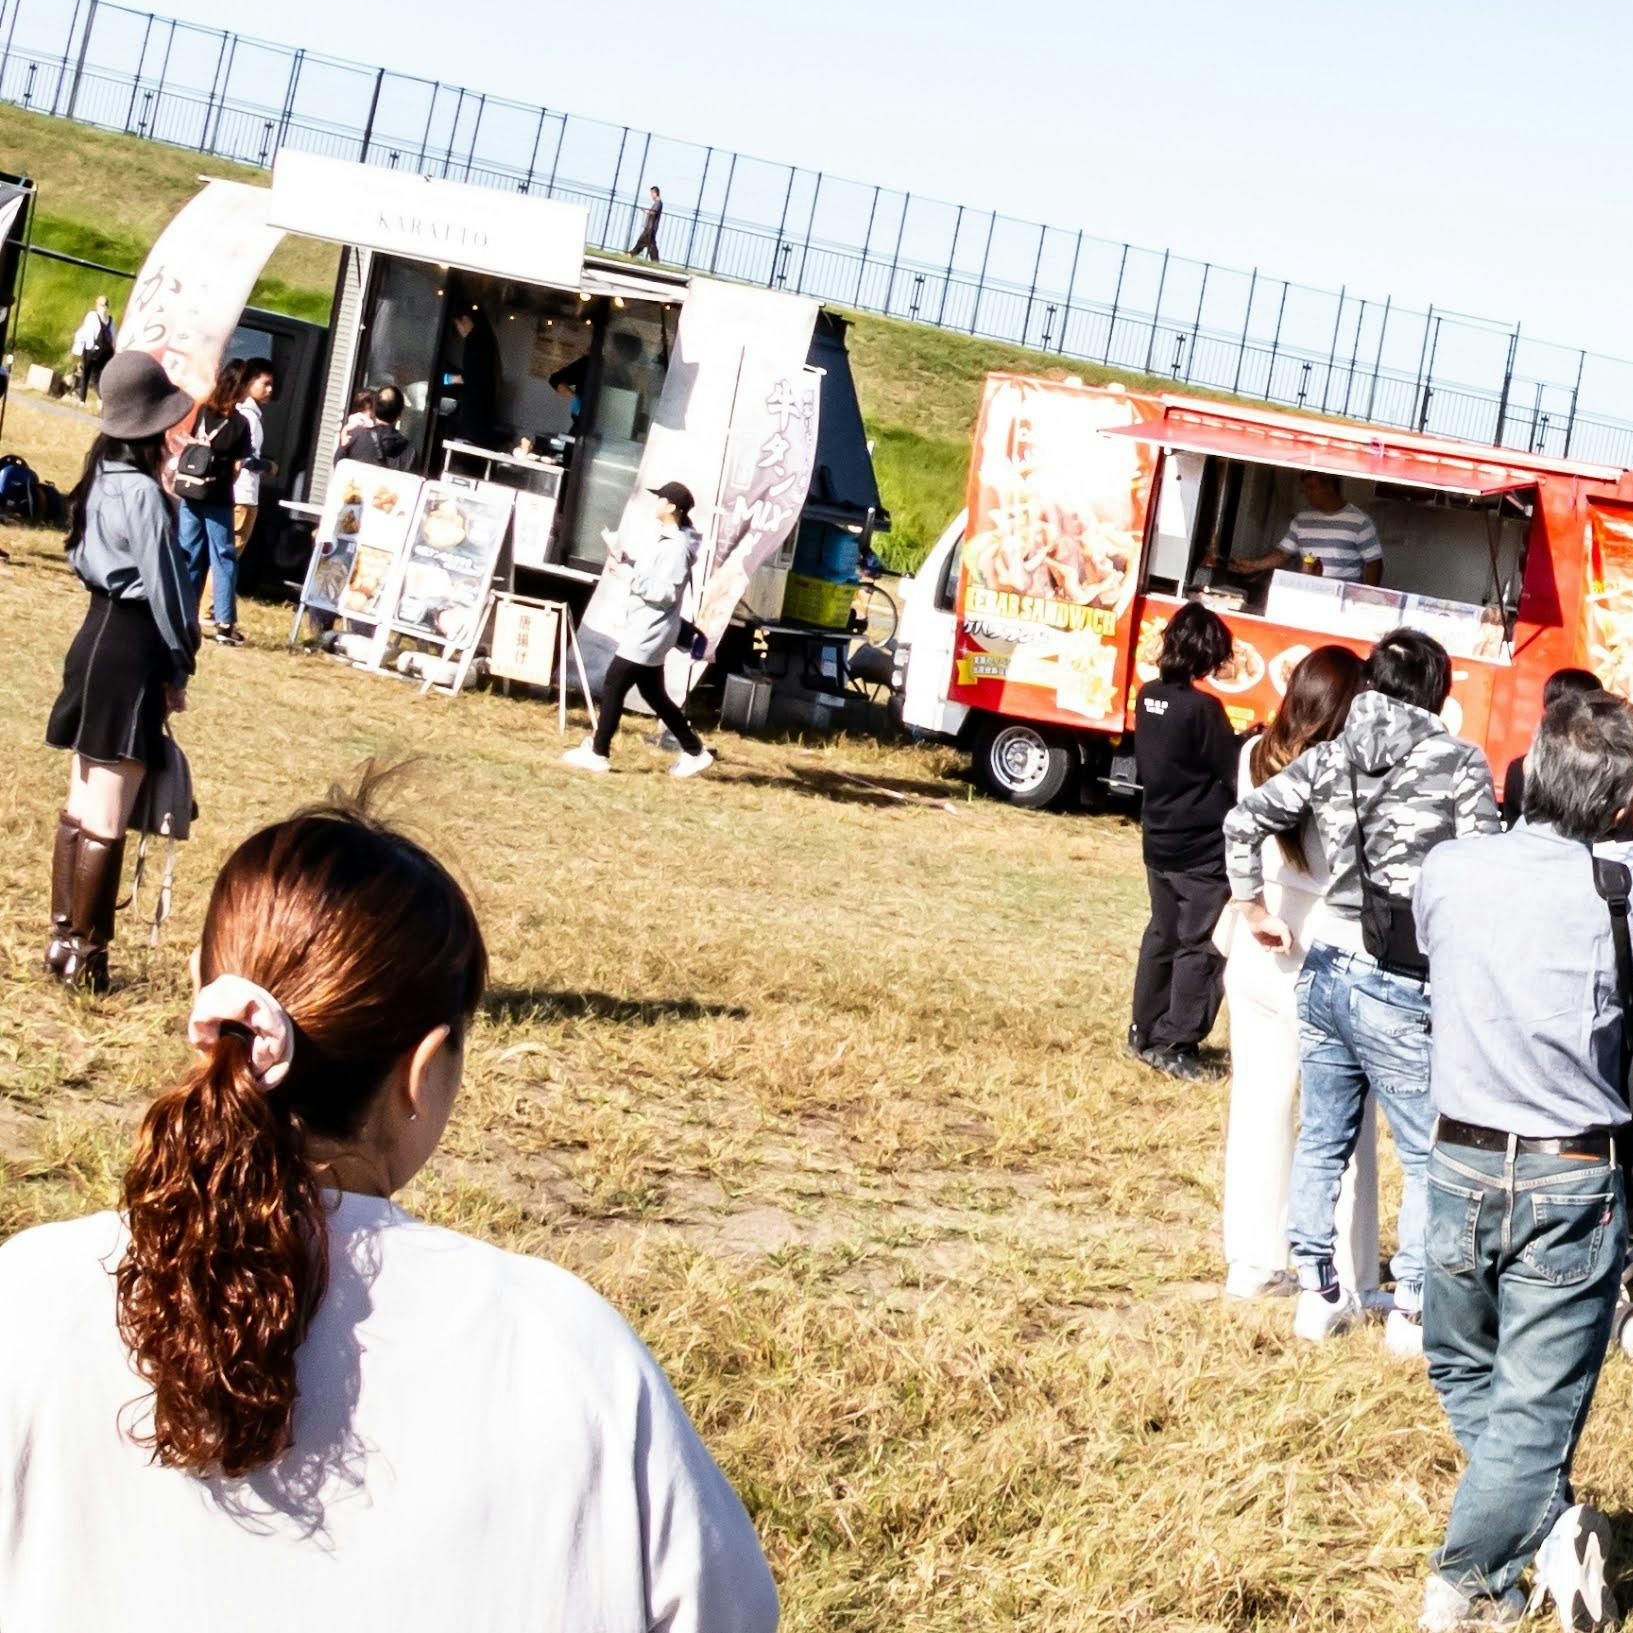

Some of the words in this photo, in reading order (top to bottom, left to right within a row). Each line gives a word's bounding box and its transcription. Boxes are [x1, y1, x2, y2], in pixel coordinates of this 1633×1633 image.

[376, 210, 490, 249] KARATTO
[965, 587, 1020, 620] KEBAB
[1020, 596, 1118, 636] SANDWICH
